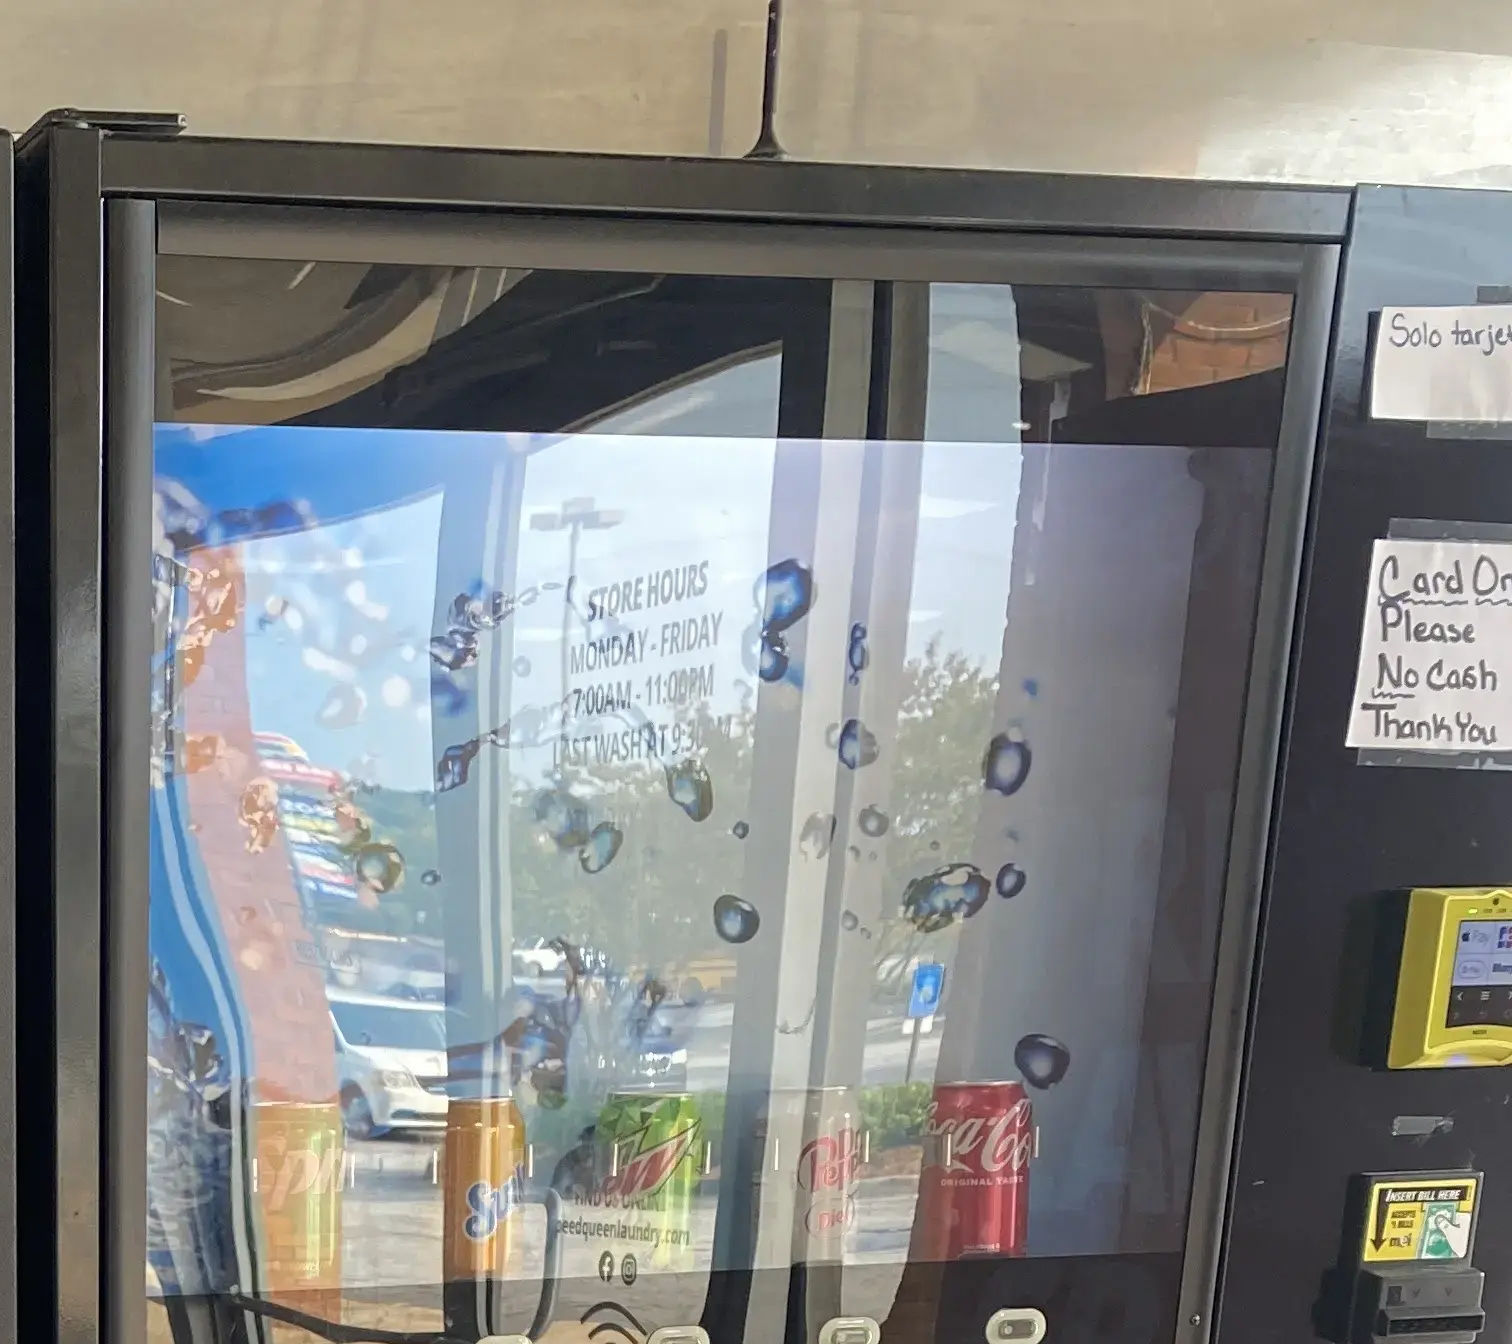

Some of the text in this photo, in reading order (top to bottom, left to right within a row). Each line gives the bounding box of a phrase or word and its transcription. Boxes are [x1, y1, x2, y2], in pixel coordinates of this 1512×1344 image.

[1389, 313, 1443, 349] Solo
[588, 560, 709, 622] STORE HOURS
[1378, 555, 1464, 601] Card
[570, 627, 649, 675] MONDAY
[660, 608, 724, 658] FRIDAY
[1380, 605, 1476, 645] Please
[1376, 652, 1498, 693] No Cash
[572, 679, 632, 719] 7:00AM
[1360, 701, 1498, 745] Thank You
[594, 727, 642, 765] WASH
[940, 1178, 994, 1188] ORIGINAL
[1385, 1188, 1462, 1203] INSERT BILL HERE
